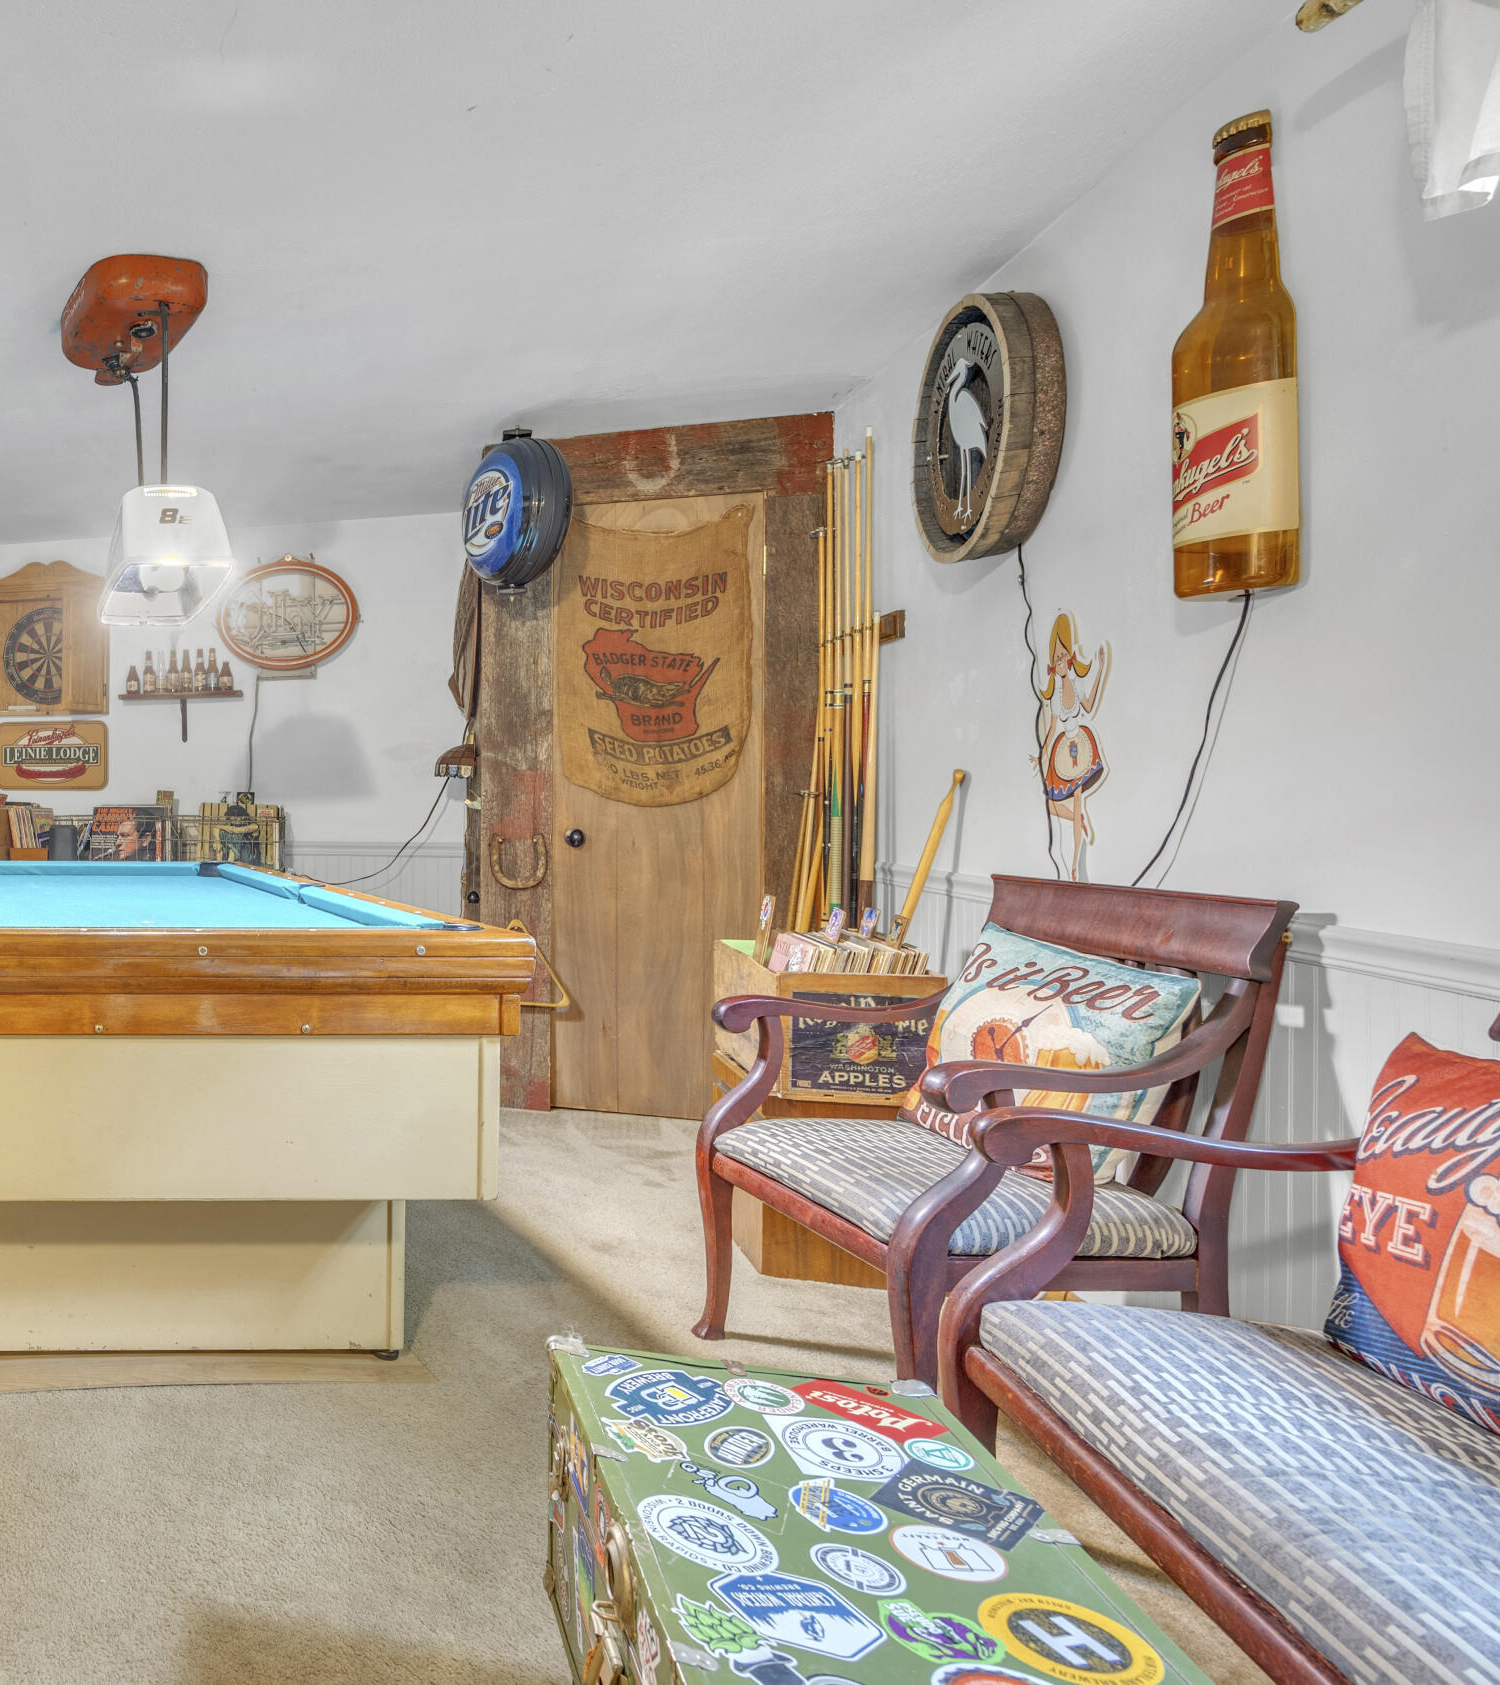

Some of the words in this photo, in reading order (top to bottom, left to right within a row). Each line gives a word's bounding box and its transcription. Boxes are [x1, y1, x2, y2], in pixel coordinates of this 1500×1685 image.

[966, 331, 998, 370] WATERS
[472, 476, 501, 503] Miller
[159, 508, 179, 524] 8
[464, 481, 512, 545] Lite
[1188, 493, 1231, 526] Beer
[578, 571, 728, 601] WISCONSIN
[584, 595, 720, 628] CERTIFIED
[592, 651, 647, 668] BADGER
[651, 655, 693, 673] STATE
[630, 712, 683, 728] BRAND
[6, 747, 48, 764] LEINIE
[52, 747, 97, 763] LODGE
[593, 733, 639, 761] SEED
[644, 731, 728, 764] POTATOES
[620, 776, 658, 791] WEIGHT
[623, 767, 654, 783] LBS.
[656, 770, 680, 780] NET
[695, 761, 721, 776] 45.36
[92, 822, 118, 832] CASH
[993, 961, 1038, 992] it
[1027, 966, 1165, 1021] Beer
[818, 1071, 907, 1089] APPLES
[829, 1063, 895, 1074] WASHINGTON
[1339, 1183, 1432, 1264] EYE
[616, 1371, 676, 1395] BREWERY
[657, 1388, 730, 1424] LAKEFRONT
[804, 1390, 933, 1432] Potosi
[789, 1423, 839, 1445] WAREHOUSE
[842, 1426, 892, 1453] BARREL
[821, 1437, 864, 1463] 3
[897, 1474, 985, 1495] GERMAIN
[674, 1497, 684, 1505] 2
[688, 1501, 734, 1522] DOORS
[897, 1491, 955, 1525] SAINT
[642, 1498, 668, 1533] WISCONSIN
[658, 1534, 709, 1565] RAPIDS
[736, 1522, 770, 1548] DOWN
[723, 1563, 743, 1574] CO
[744, 1548, 774, 1574] BREWING
[730, 1591, 786, 1607] WATERS
[758, 1583, 802, 1591] BREWING
[777, 1591, 836, 1607] CENTRAL
[1017, 1615, 1123, 1668] H
